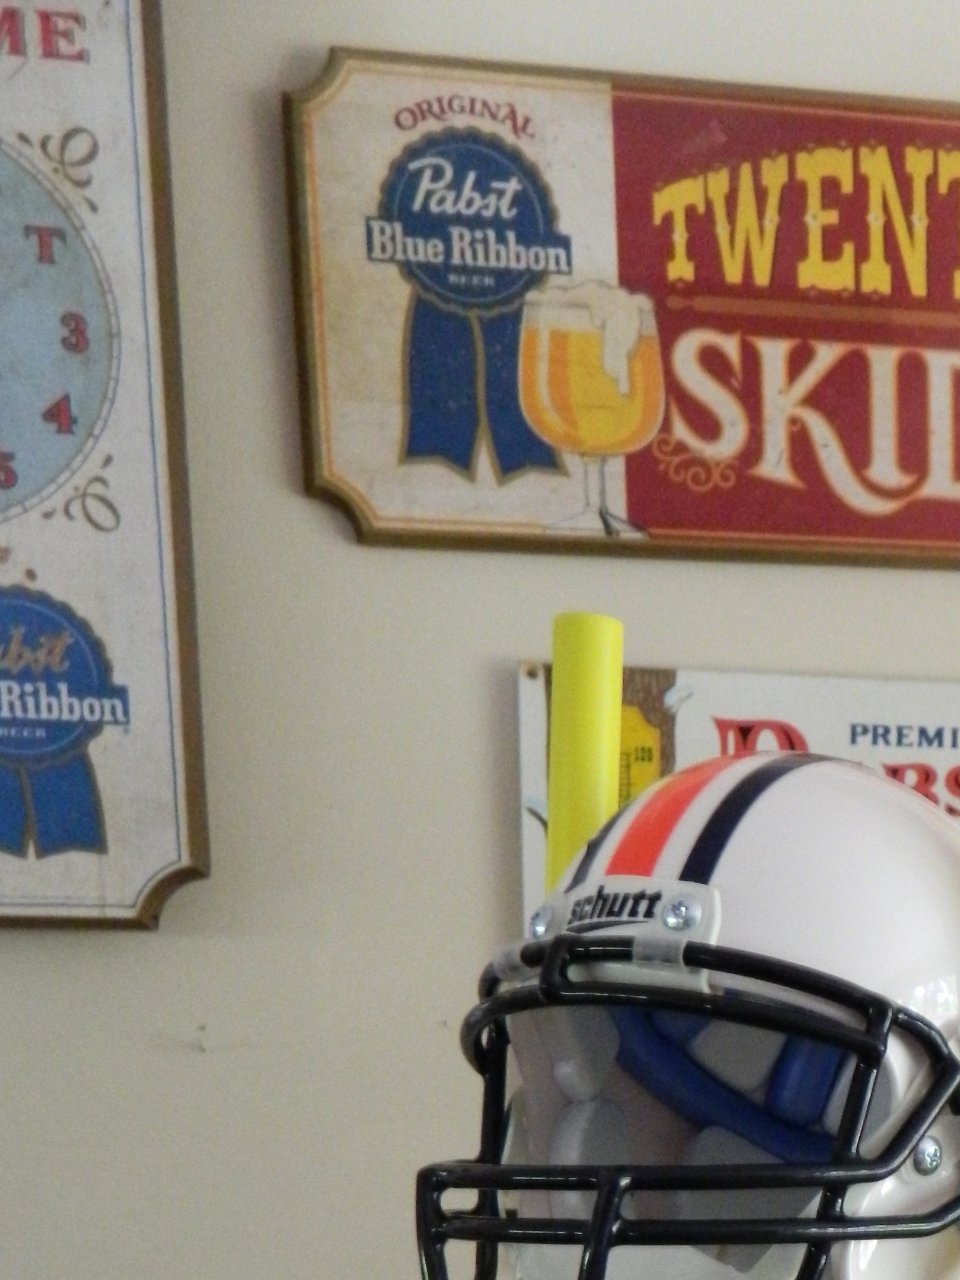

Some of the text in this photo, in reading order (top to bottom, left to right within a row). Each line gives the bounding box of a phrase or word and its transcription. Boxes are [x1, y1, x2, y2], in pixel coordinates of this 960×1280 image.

[394, 95, 536, 139] ORIGINAL
[407, 156, 522, 219] Pabst
[23, 224, 67, 264] T
[369, 219, 569, 273] Blue Ribbon
[60, 312, 90, 353] 3
[41, 393, 78, 436] 4
[0, 625, 73, 674] bst
[0, 680, 127, 722] Ribbon
[568, 885, 662, 925] schutt
